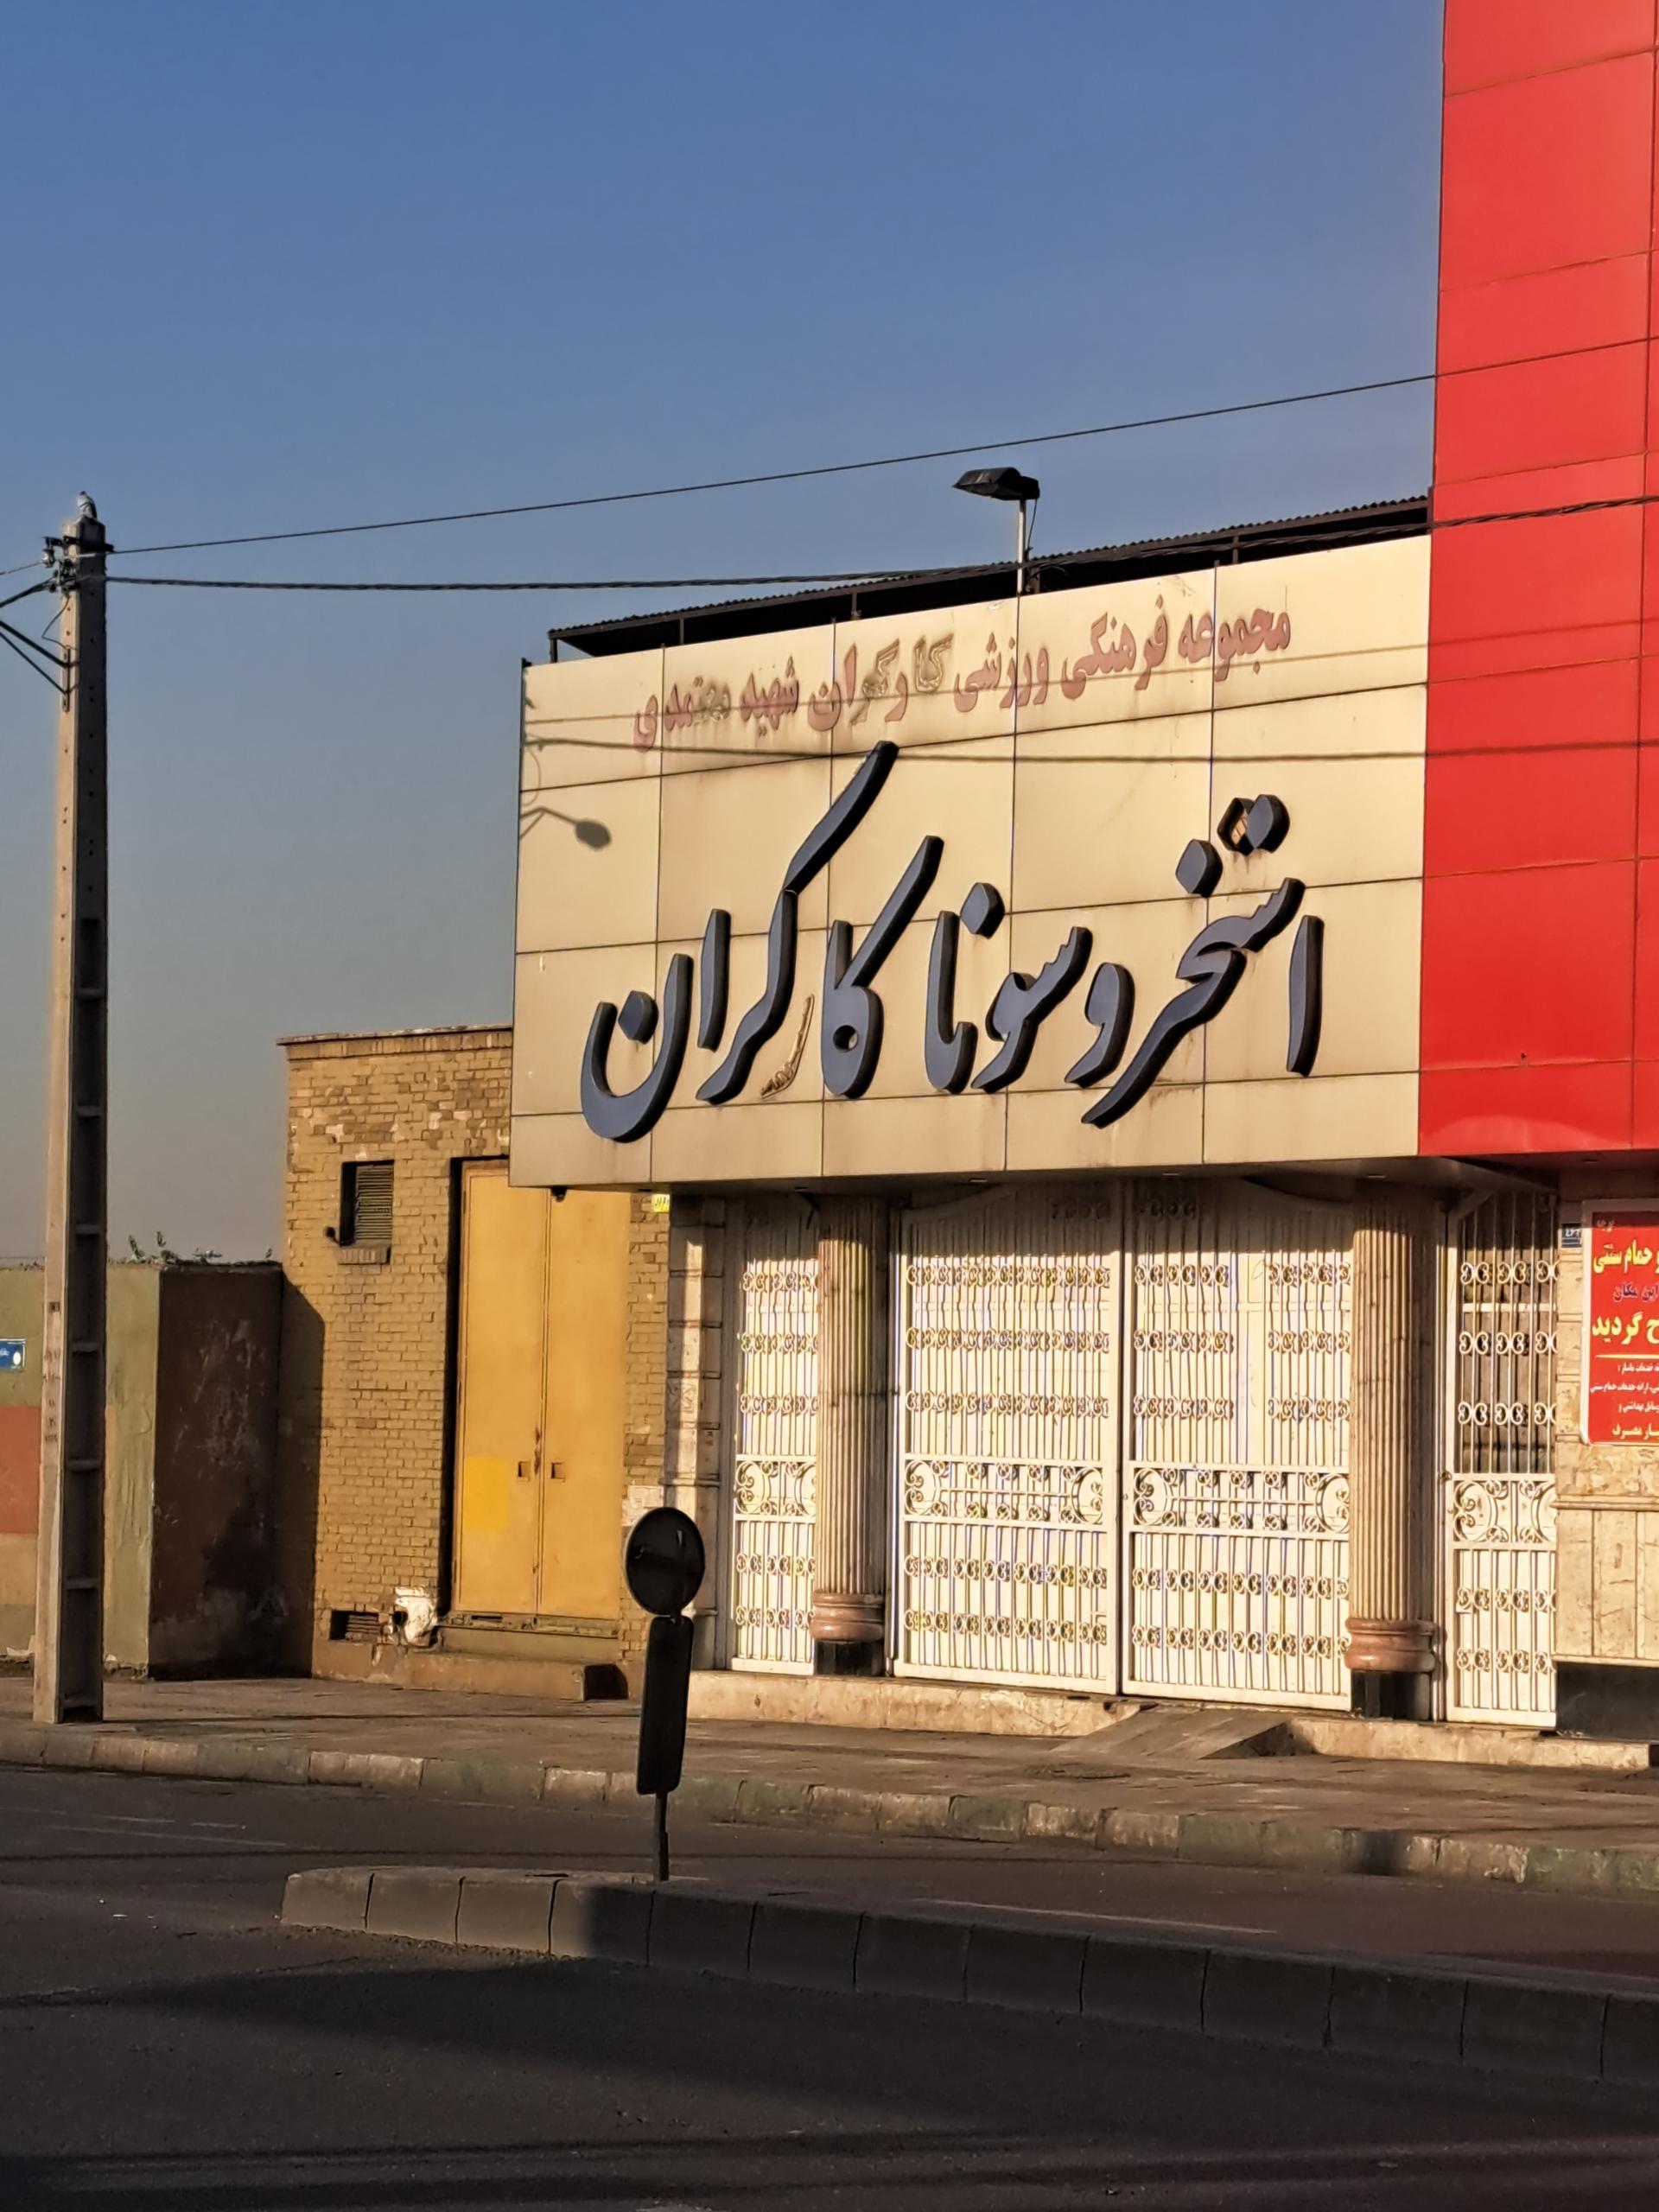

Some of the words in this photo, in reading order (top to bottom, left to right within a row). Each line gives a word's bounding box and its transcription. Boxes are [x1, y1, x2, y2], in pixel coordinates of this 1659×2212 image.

[953, 632, 1048, 713] ورزشی
[1059, 594, 1168, 701] فرهنگی
[1178, 607, 1291, 683] مجموعه
[740, 655, 800, 738] شهید
[923, 881, 1095, 1096] سونا
[1081, 793, 1325, 1130] استخر
[1064, 961, 1135, 1089] و
[1592, 1311, 1643, 1344] گردید
